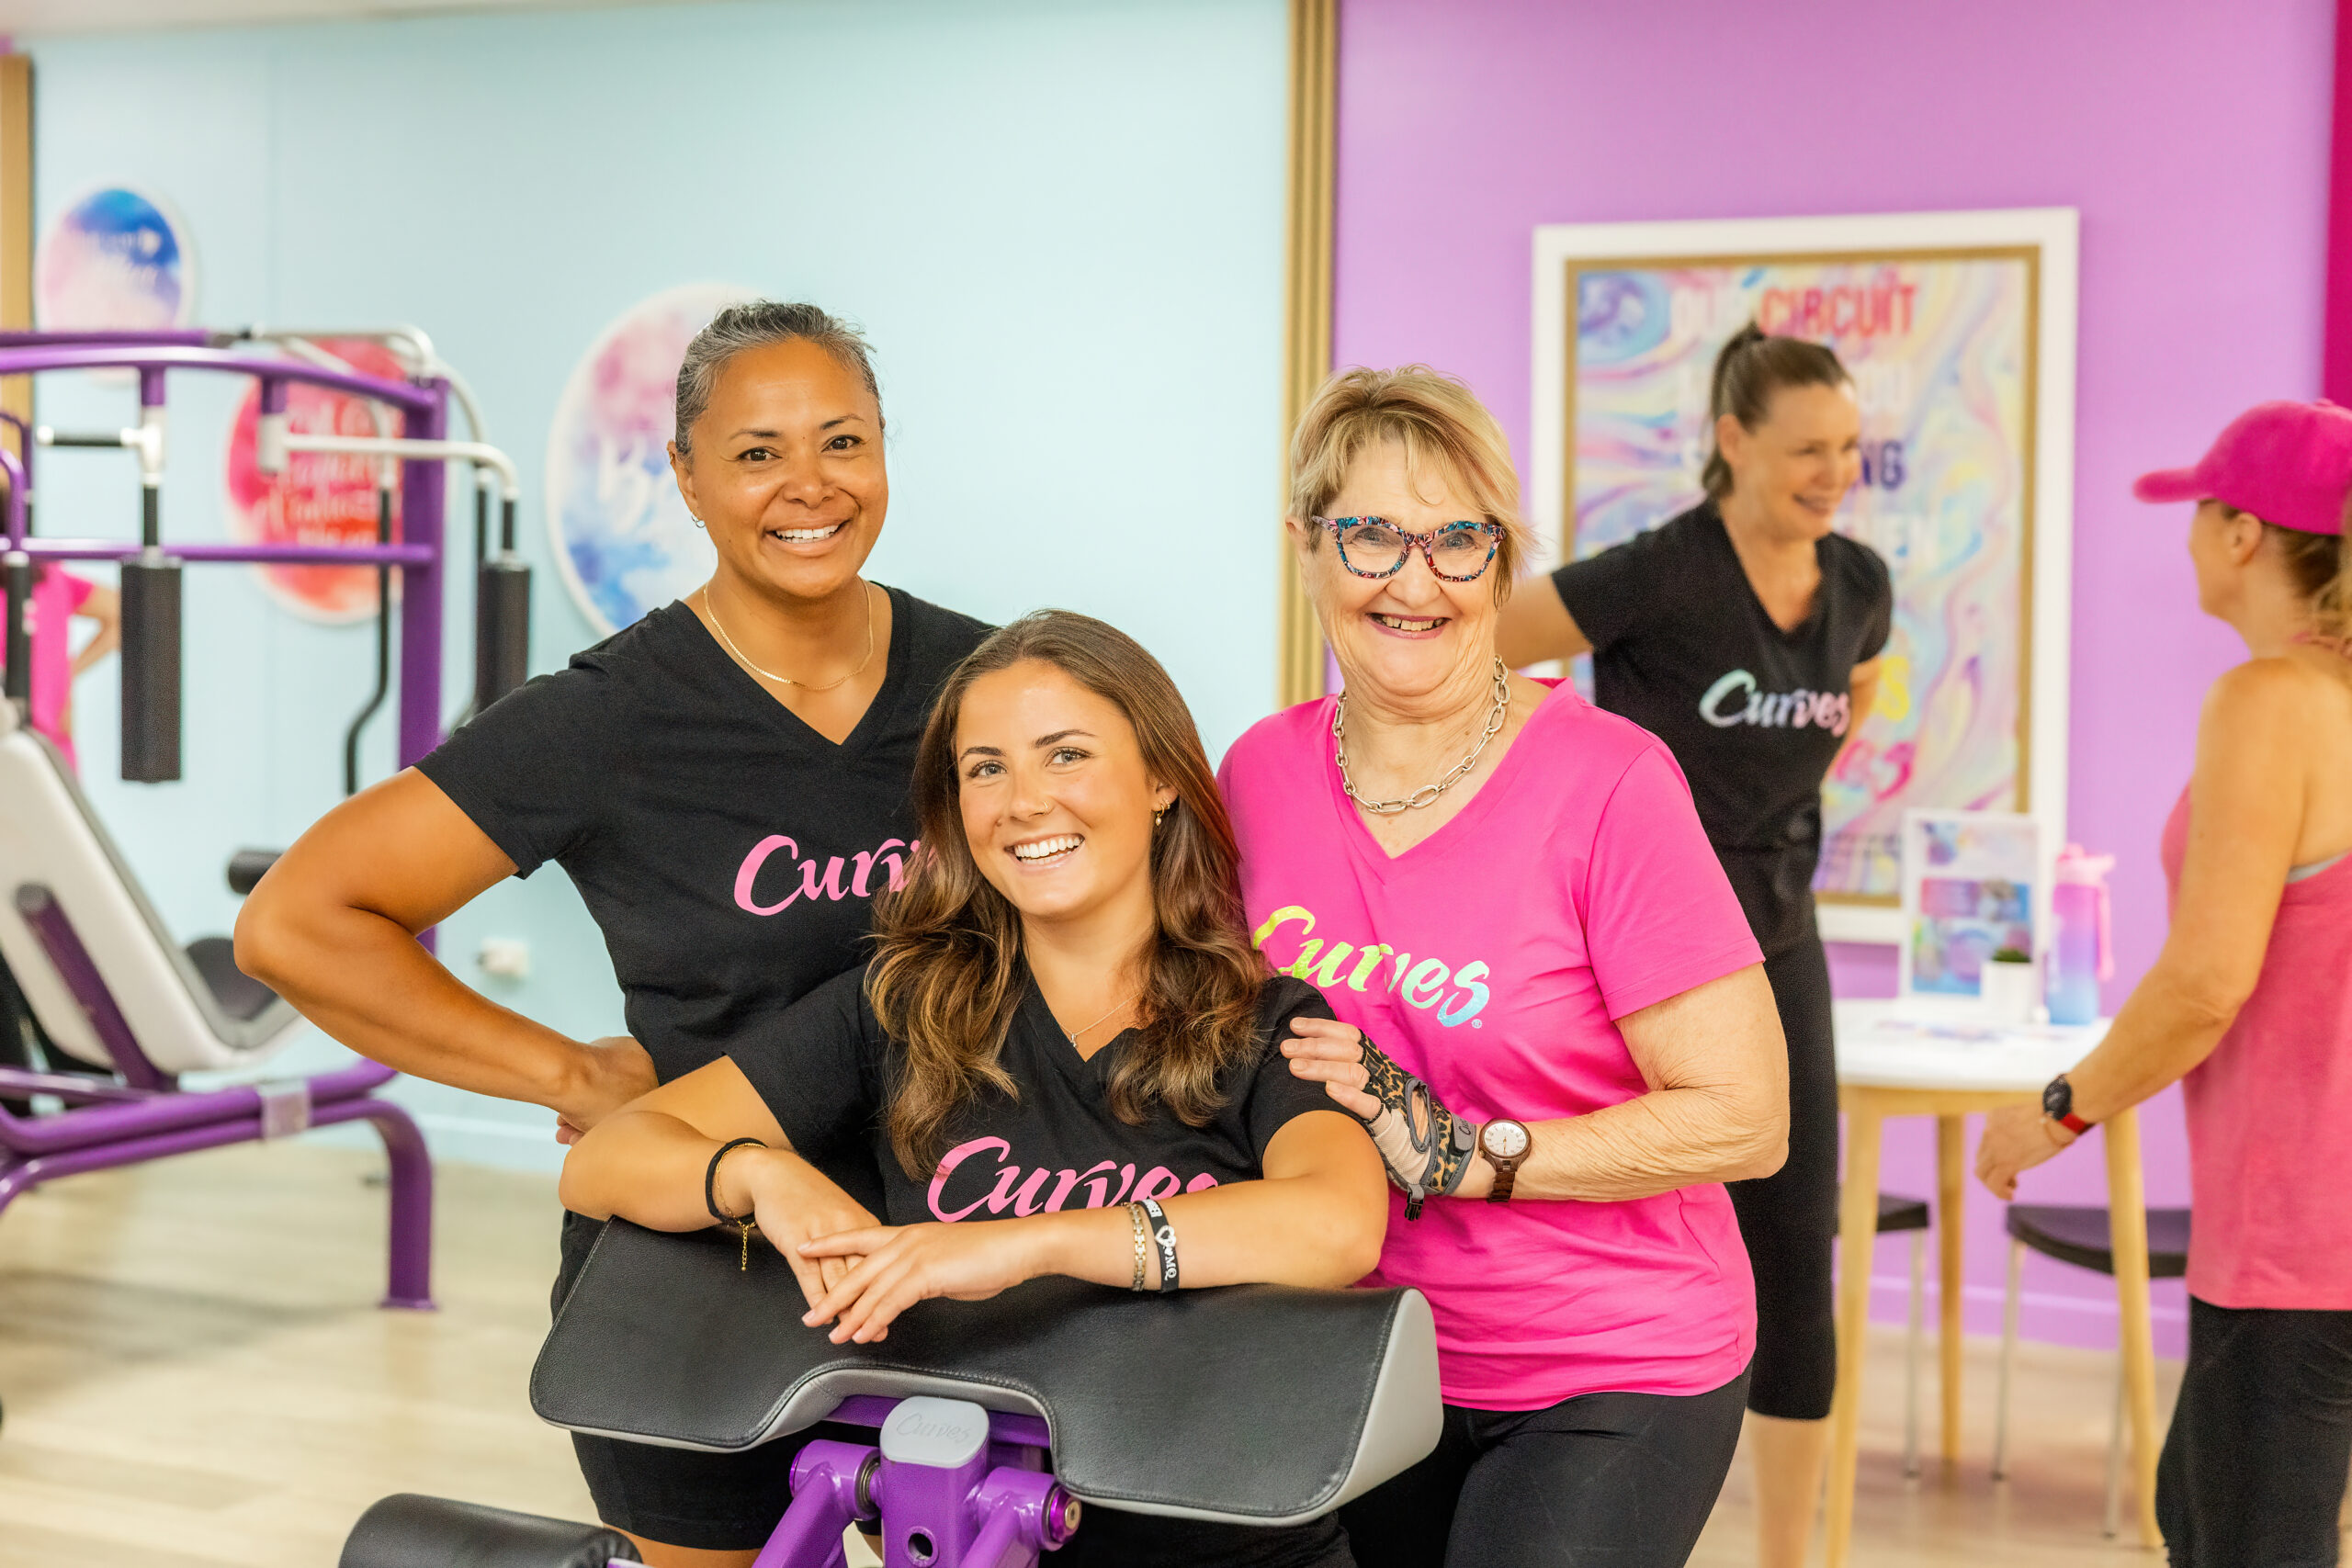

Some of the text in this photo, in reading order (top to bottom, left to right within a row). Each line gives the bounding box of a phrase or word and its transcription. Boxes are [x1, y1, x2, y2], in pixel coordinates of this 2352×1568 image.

[1760, 284, 1917, 339] CIRCUIT
[1699, 669, 1850, 736] Curves
[896, 1412, 972, 1443] Curves
